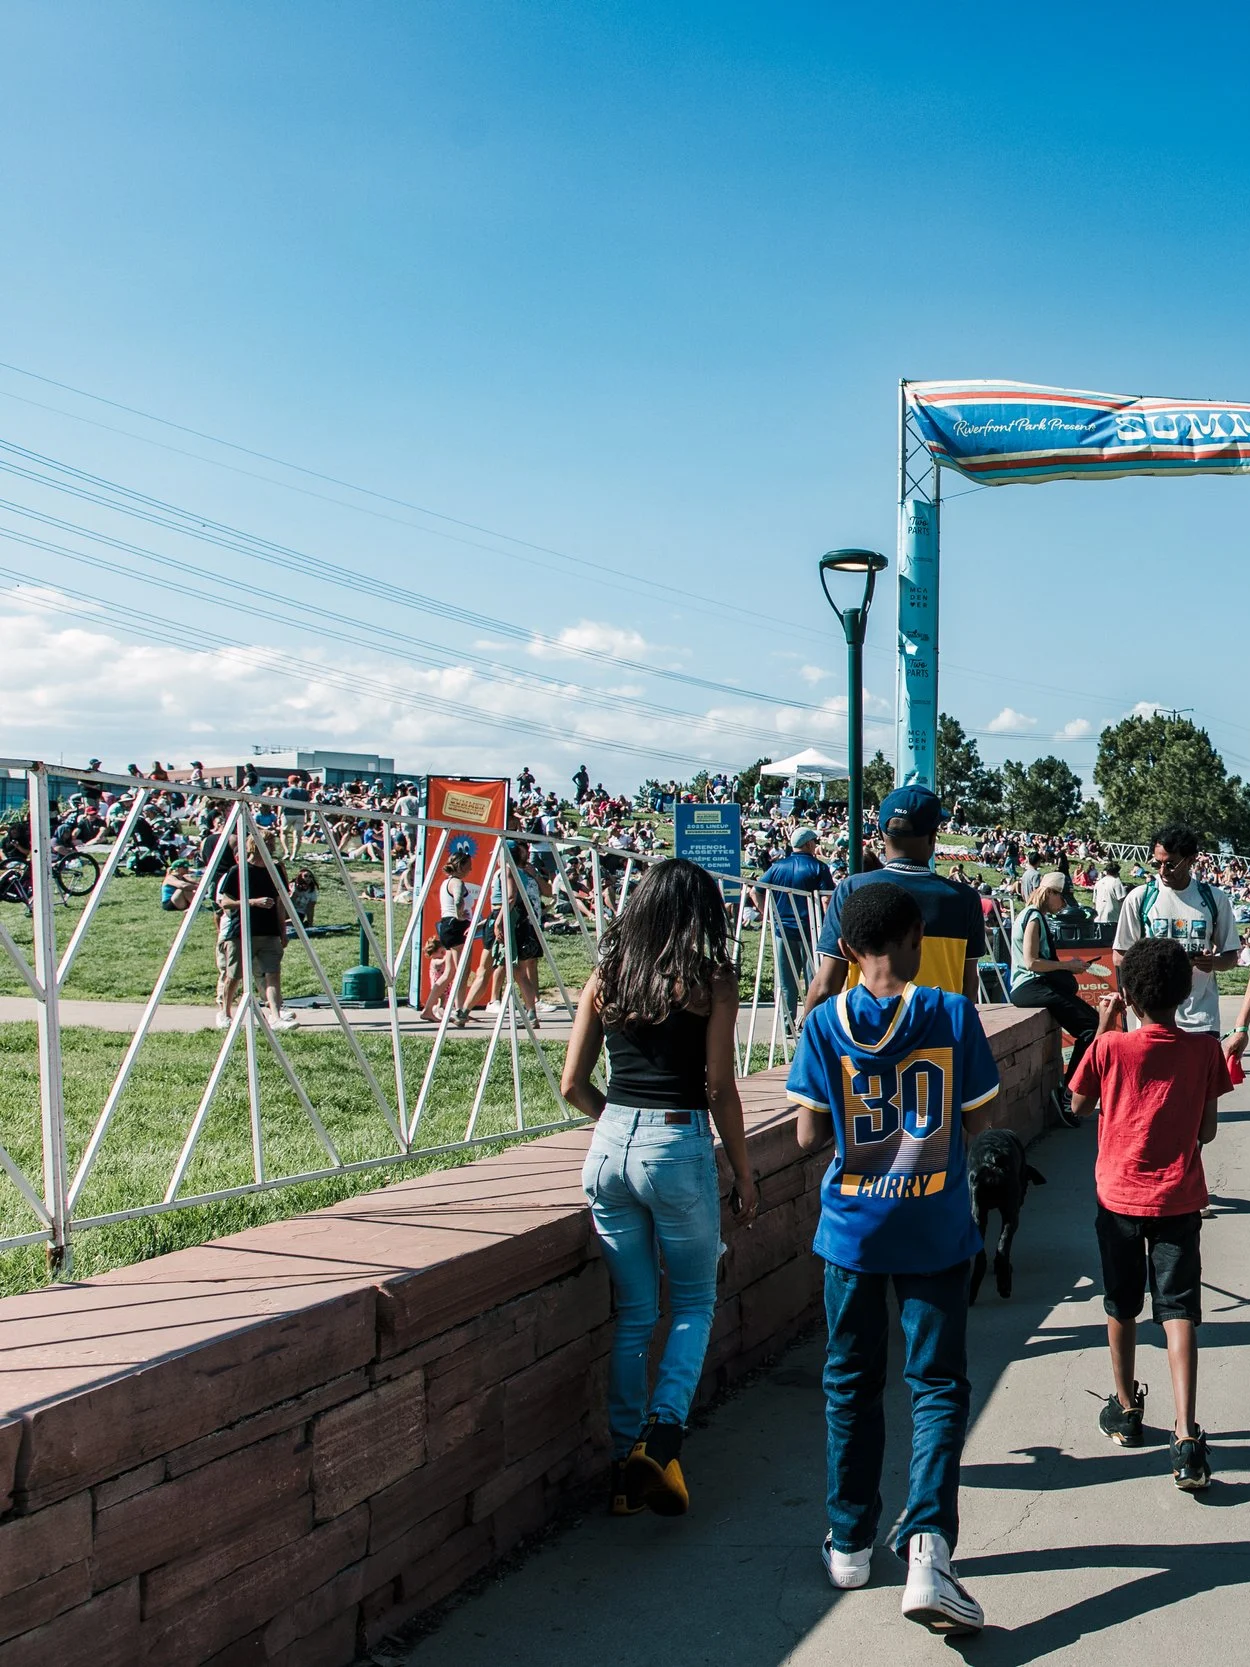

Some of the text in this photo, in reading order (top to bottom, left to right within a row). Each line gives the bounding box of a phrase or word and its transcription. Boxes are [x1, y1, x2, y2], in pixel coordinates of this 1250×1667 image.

[953, 417, 1097, 437] Riverfront Park Presents
[909, 515, 929, 527] Two
[908, 526, 930, 536] PARTS
[908, 658, 928, 669] Two
[907, 669, 929, 678] PARTS
[1078, 983, 1109, 991] USIC
[851, 1059, 945, 1146] 30
[858, 1174, 931, 1198] CURRY
